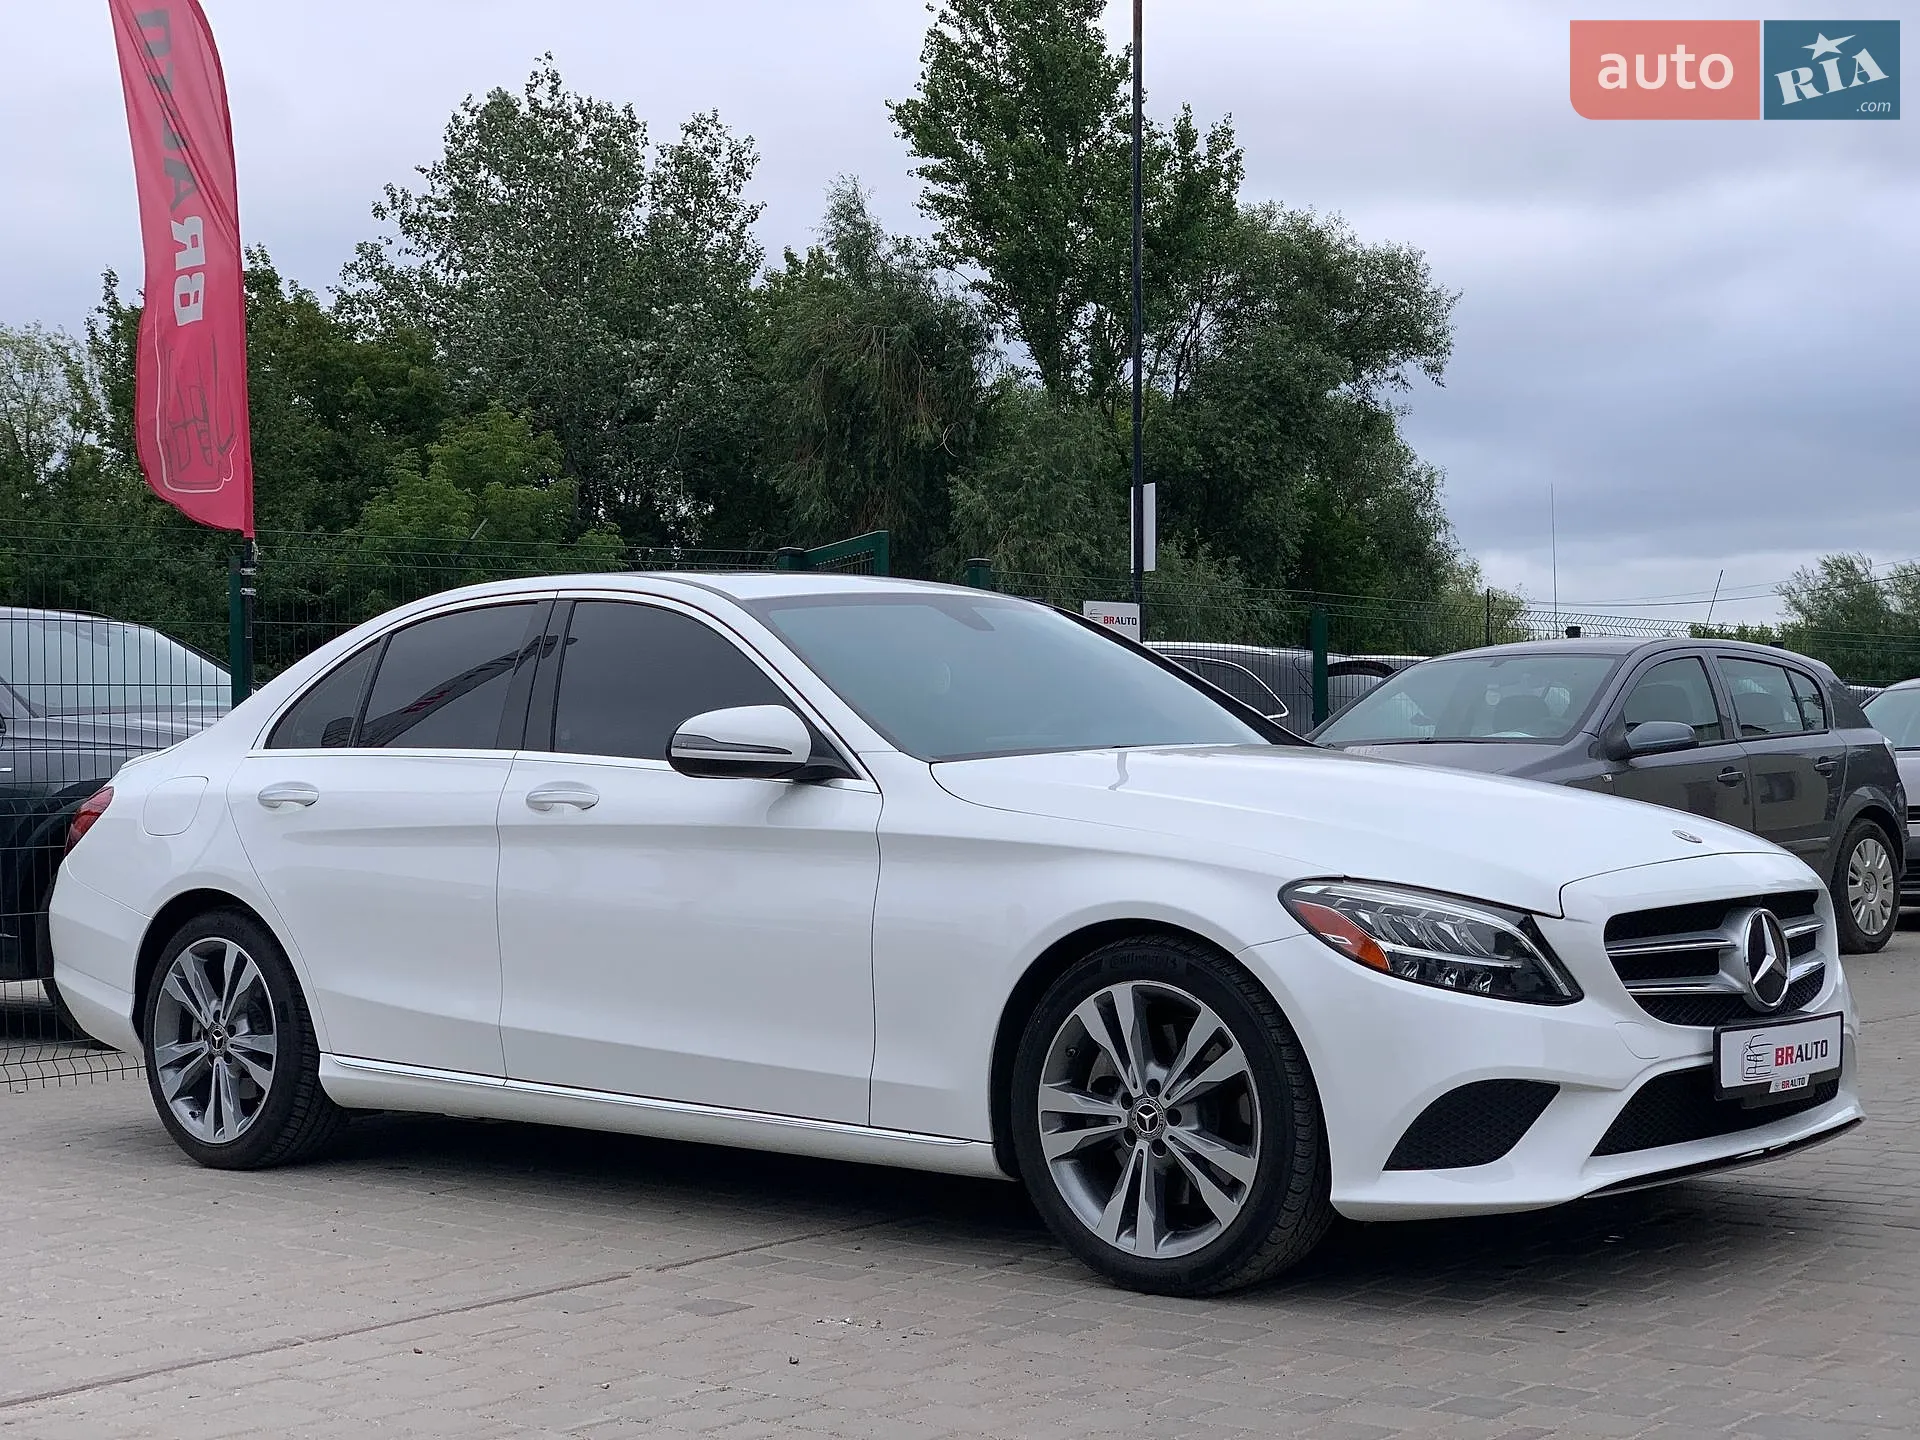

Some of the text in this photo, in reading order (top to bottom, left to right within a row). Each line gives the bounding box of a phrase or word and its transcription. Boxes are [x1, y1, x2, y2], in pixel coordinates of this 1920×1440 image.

[1103, 616, 1137, 626] BRAUTO
[1774, 1039, 1828, 1067] BRAUTO
[1781, 1077, 1806, 1089] BRAUTO
